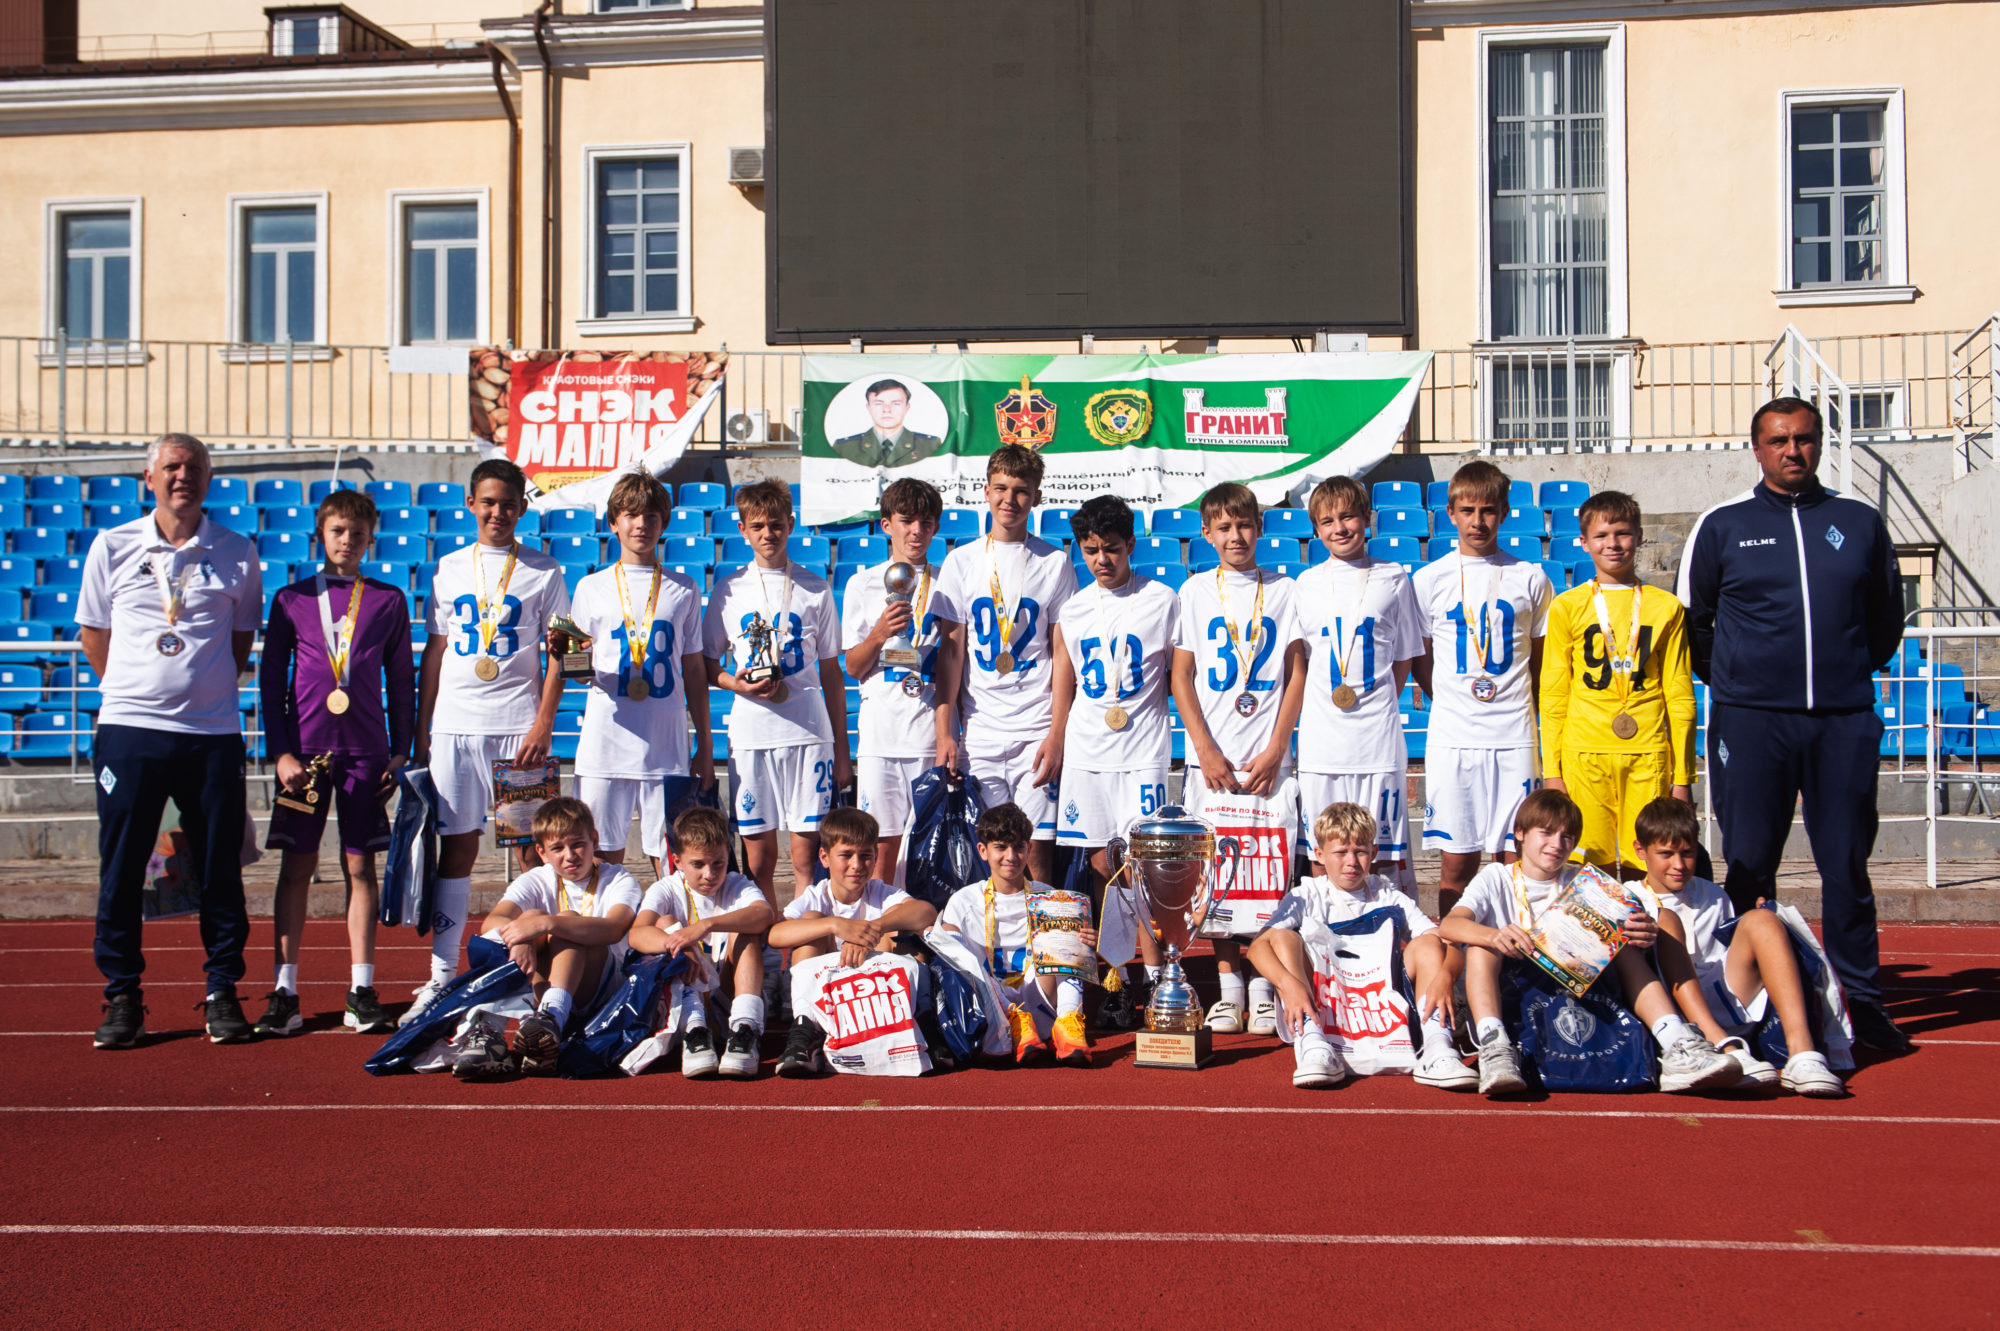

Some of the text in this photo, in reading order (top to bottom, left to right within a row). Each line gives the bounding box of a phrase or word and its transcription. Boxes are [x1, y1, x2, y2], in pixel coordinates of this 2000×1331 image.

[616, 374, 655, 384] СНЭКИ
[520, 388, 677, 423] СНЭК
[1186, 412, 1285, 435] ГРАНИТ
[1043, 481, 1111, 491] майора
[1739, 538, 1777, 548] KELME
[453, 593, 523, 657] 33
[971, 596, 1040, 672] 92
[1446, 599, 1515, 676] 10
[611, 619, 675, 698] 18
[1080, 633, 1145, 700] 50
[1207, 616, 1278, 692] 32
[1321, 616, 1376, 693] 11
[1140, 783, 1166, 816] 50
[1380, 788, 1400, 822] 11
[1216, 834, 1283, 857] НЭК
[1214, 856, 1285, 891] АНИЯ
[1568, 904, 1611, 938] ГРАМОТА
[828, 973, 905, 1006] НЭК
